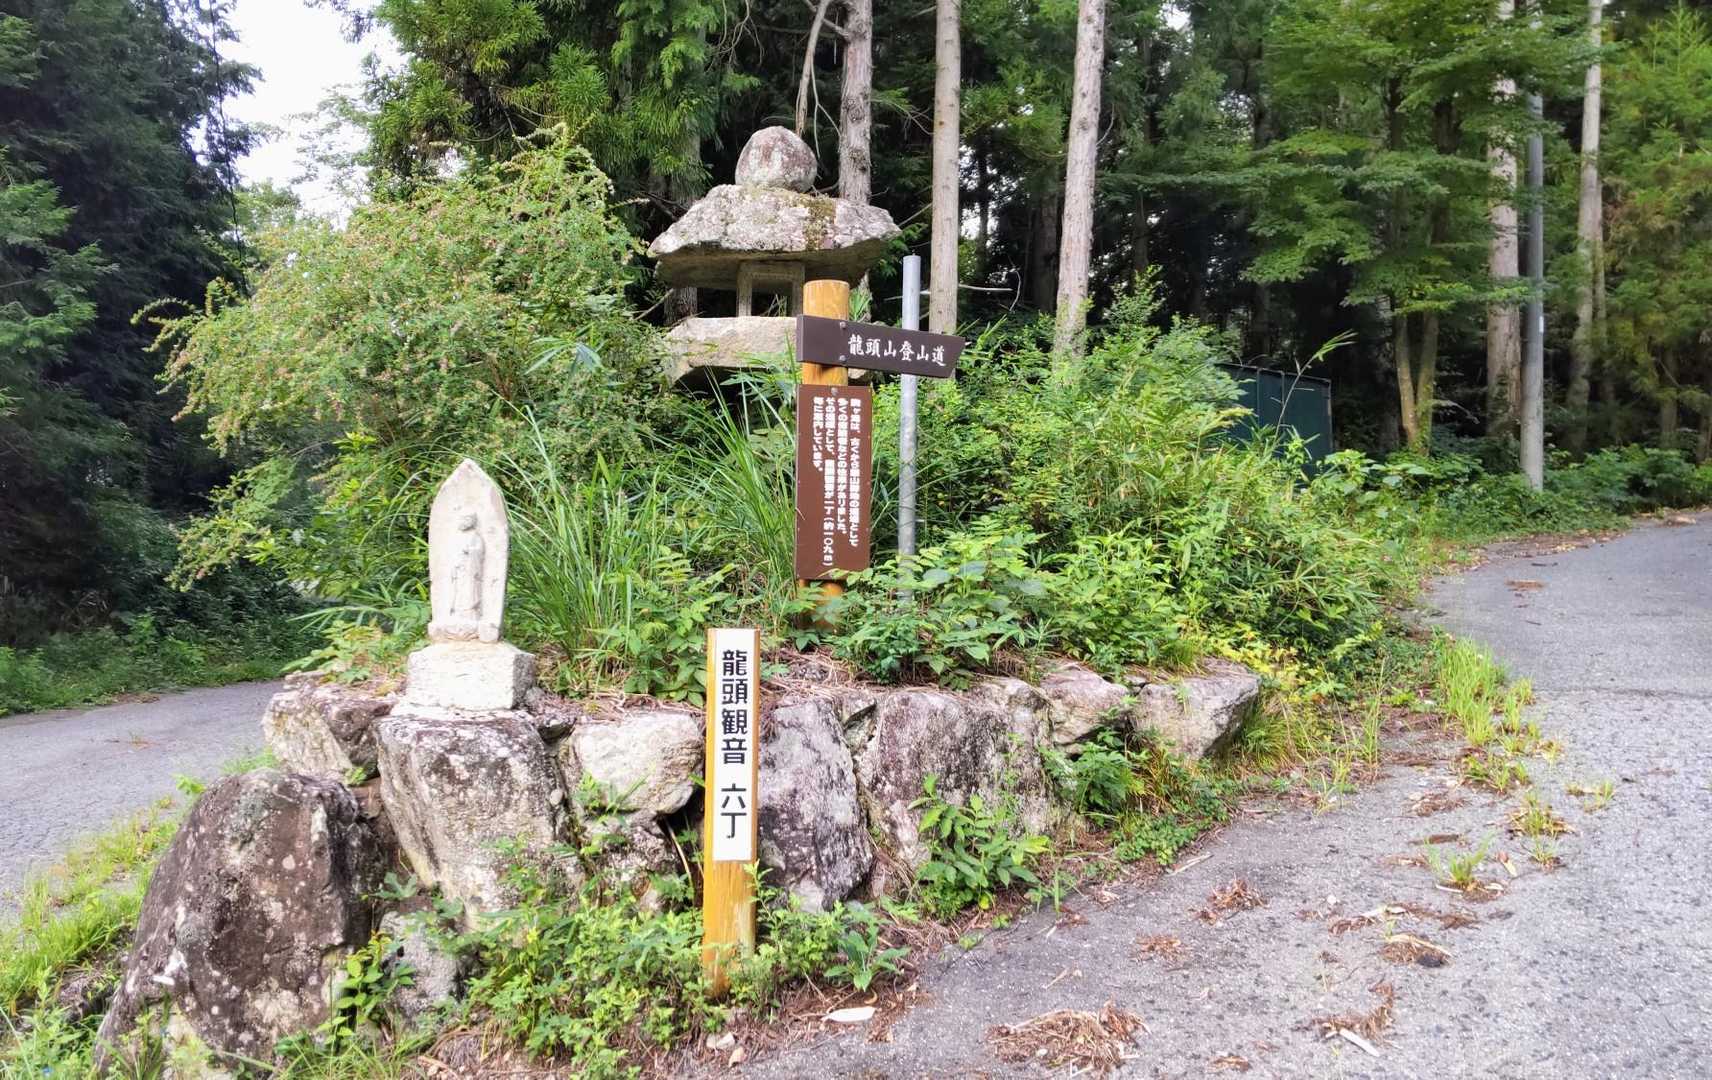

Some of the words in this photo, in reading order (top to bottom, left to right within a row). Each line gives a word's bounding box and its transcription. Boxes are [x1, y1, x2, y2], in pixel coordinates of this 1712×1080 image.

[848, 333, 947, 367] 龍頭山登山道
[721, 649, 748, 765] 龍頭観音
[720, 783, 747, 839] 六丁
